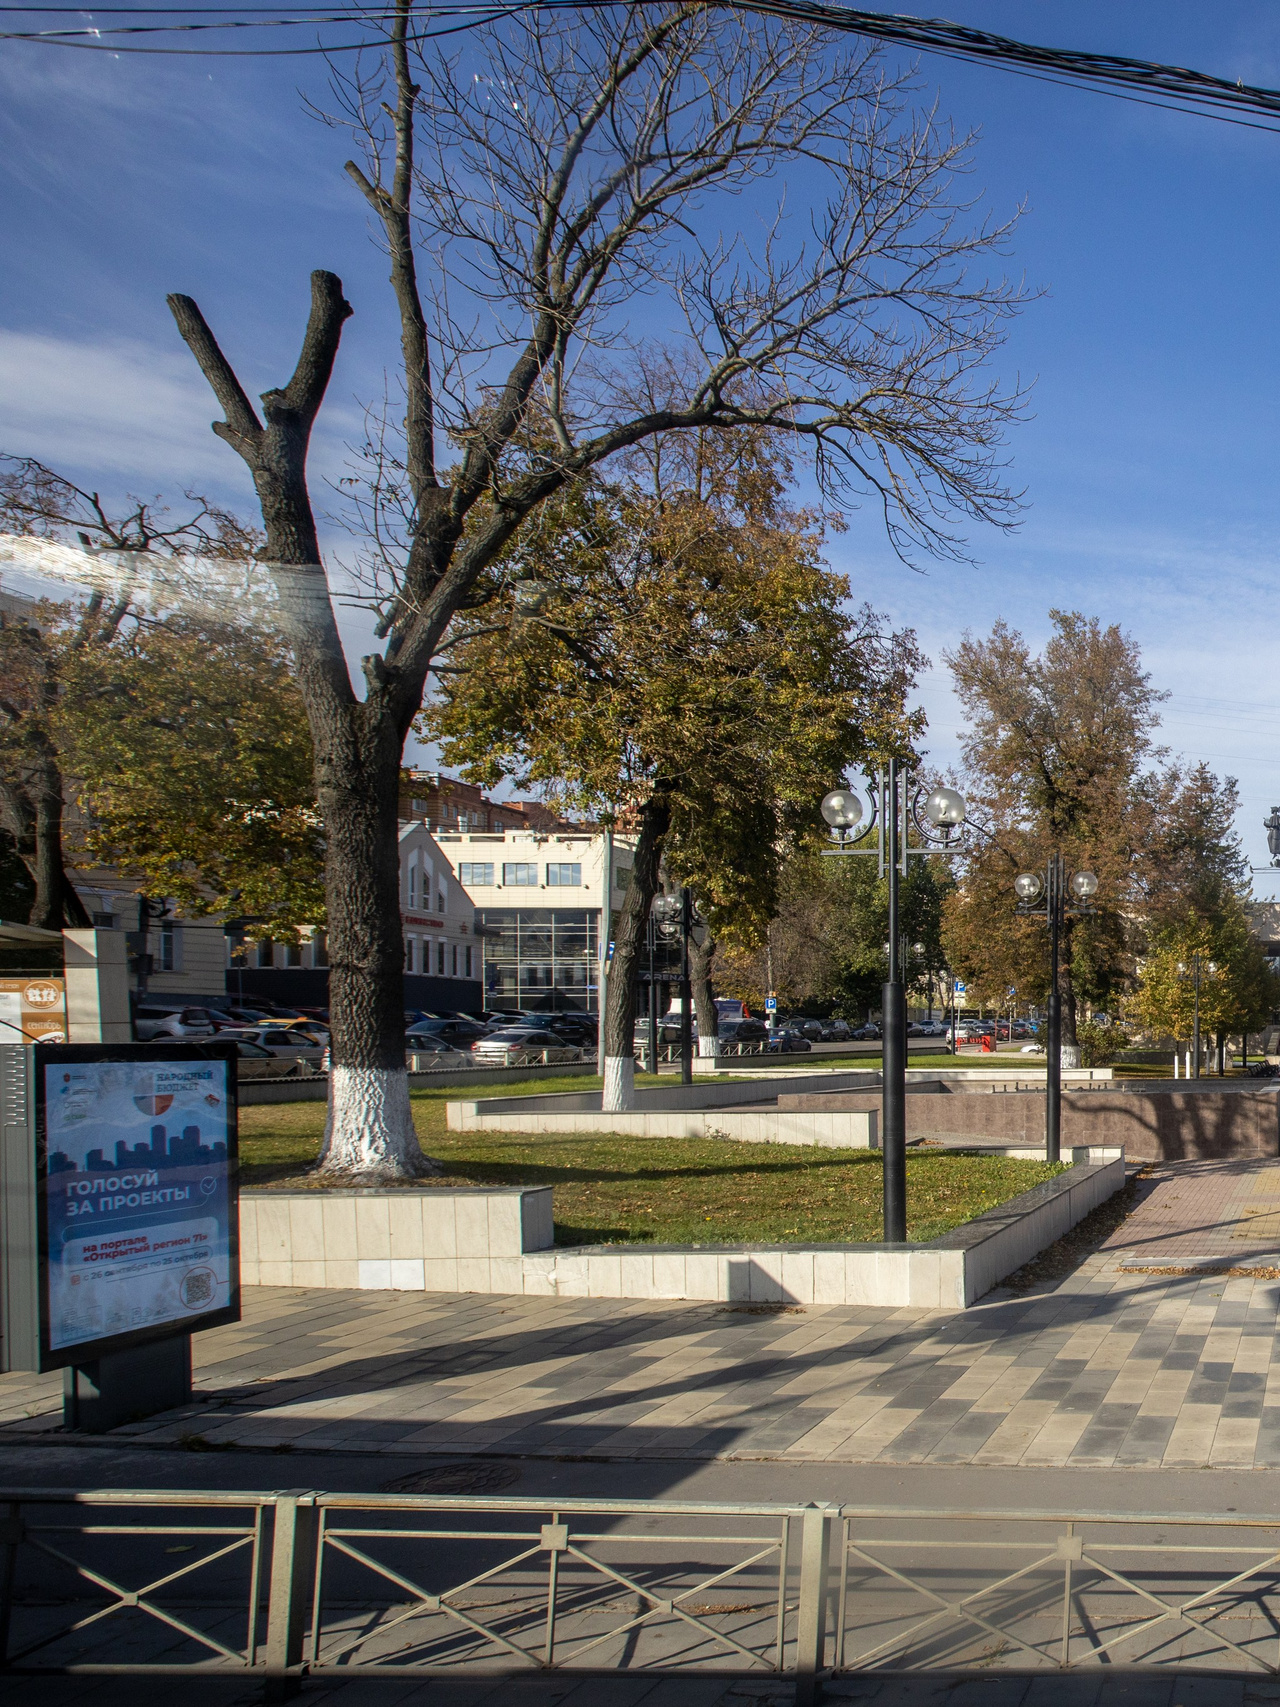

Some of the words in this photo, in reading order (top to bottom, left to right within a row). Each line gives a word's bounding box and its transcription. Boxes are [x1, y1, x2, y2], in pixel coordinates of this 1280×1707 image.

[768, 999, 775, 1008] P
[157, 1070, 213, 1082] НАРОДНЫЙ
[157, 1083, 199, 1093] БЮДЖЕТ
[65, 1169, 159, 1197] ГОЛОСУЙ
[66, 1199, 95, 1217] ЗА
[99, 1185, 190, 1212] ПРОЕКТЫ
[83, 1244, 98, 1254] на
[100, 1235, 148, 1251] портале
[83, 1242, 150, 1263] «Открытый
[153, 1236, 191, 1252] регион
[91, 1271, 103, 1280] 26
[104, 1263, 148, 1277] сентября
[150, 1260, 161, 1269] по
[174, 1249, 209, 1263] октября
